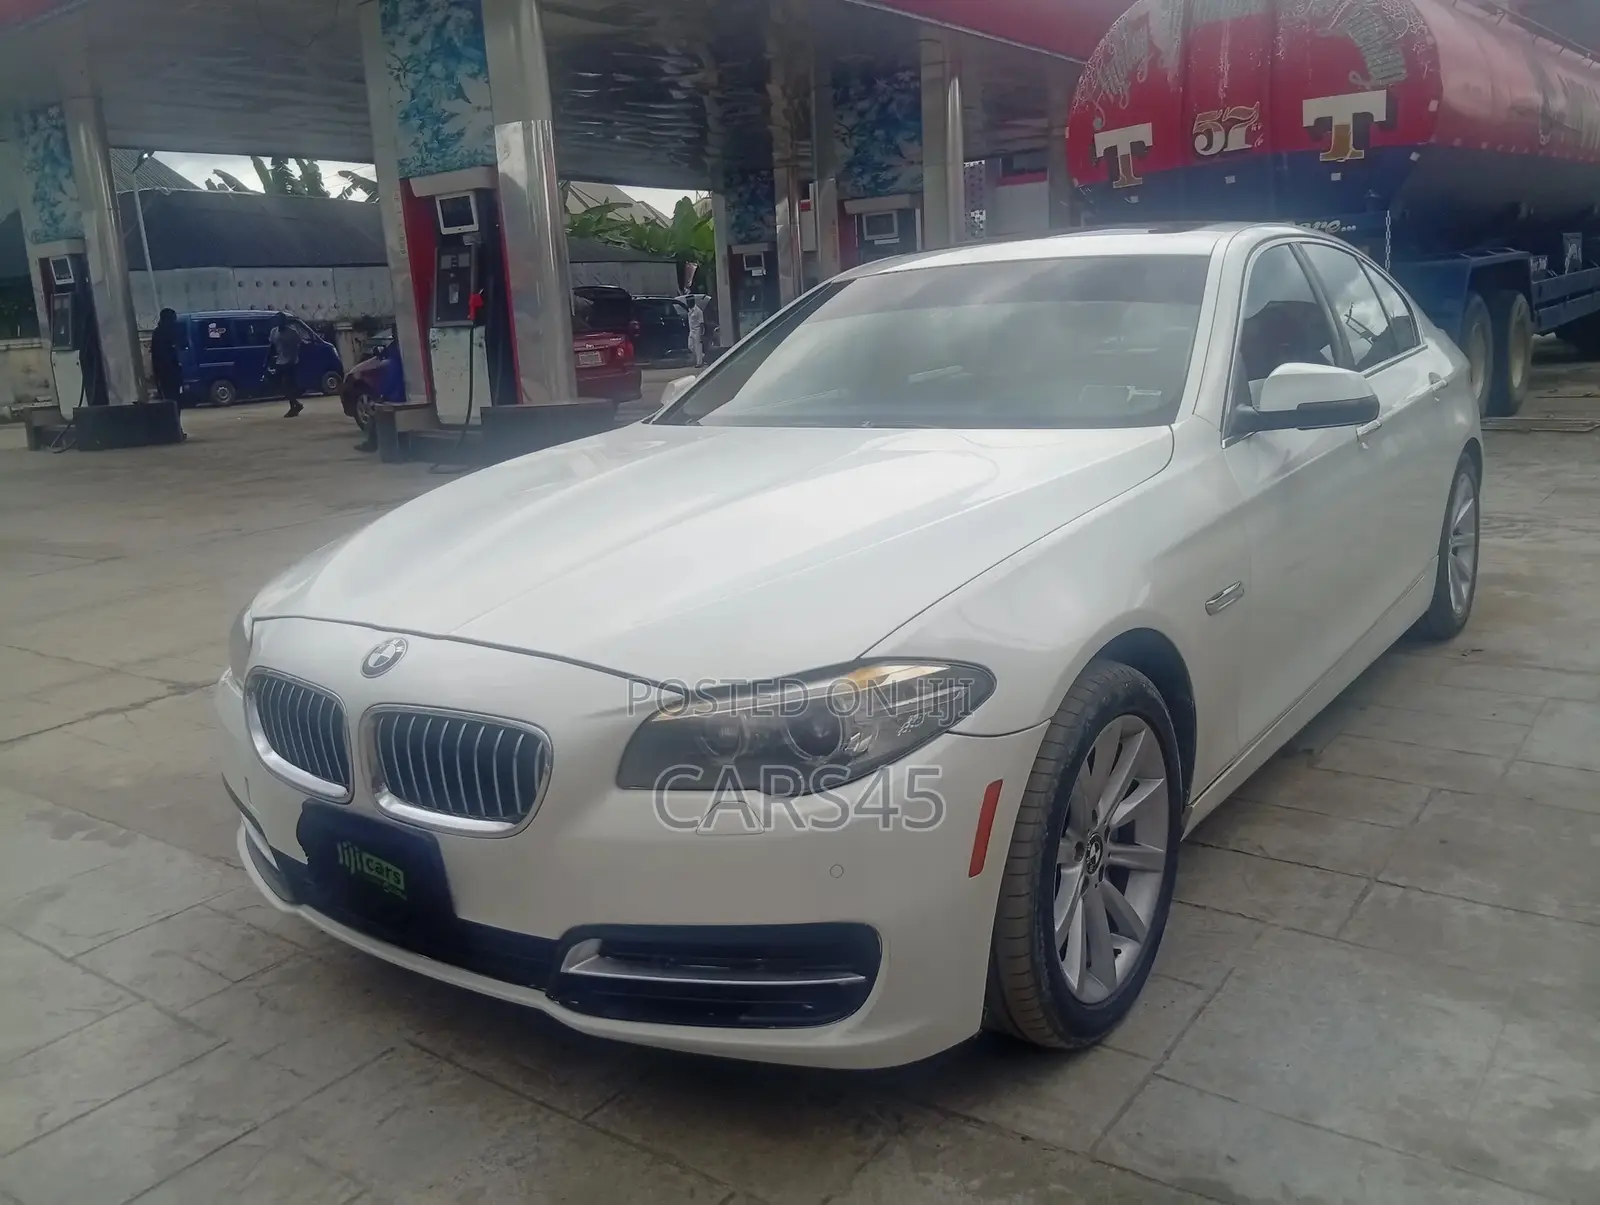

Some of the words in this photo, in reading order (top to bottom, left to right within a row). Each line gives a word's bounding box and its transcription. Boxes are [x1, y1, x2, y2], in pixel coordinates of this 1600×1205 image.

[1094, 122, 1153, 188] T
[1192, 101, 1260, 155] 57
[1302, 89, 1387, 162] T
